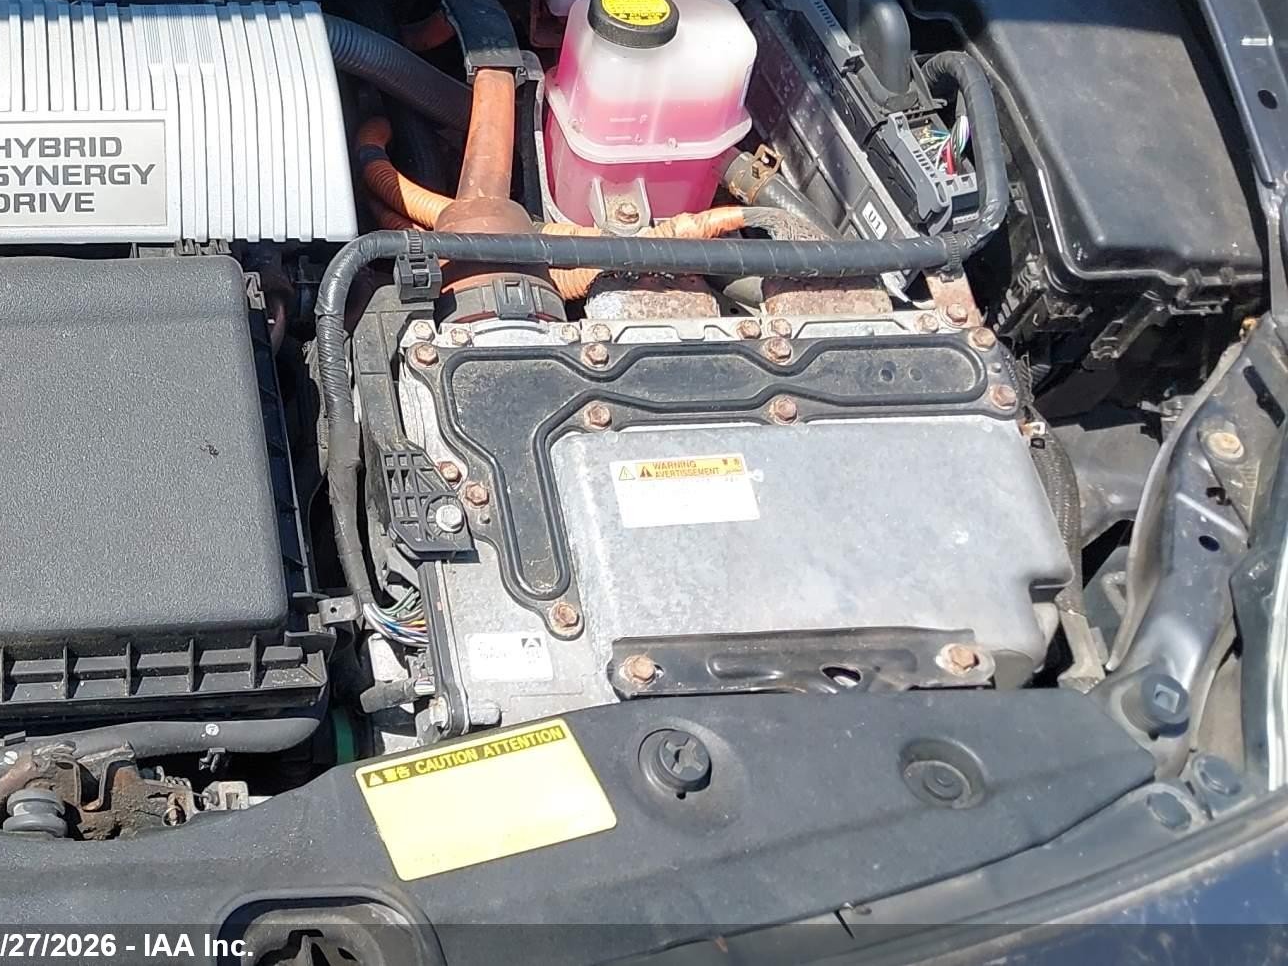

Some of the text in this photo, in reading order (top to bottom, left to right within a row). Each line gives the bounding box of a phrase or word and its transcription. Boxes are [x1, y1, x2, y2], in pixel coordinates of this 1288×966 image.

[652, 460, 697, 470] WARNING
[655, 467, 720, 478] AVERTISSEMENT
[415, 749, 479, 774] CAUTION
[483, 728, 564, 758] ATTENTION
